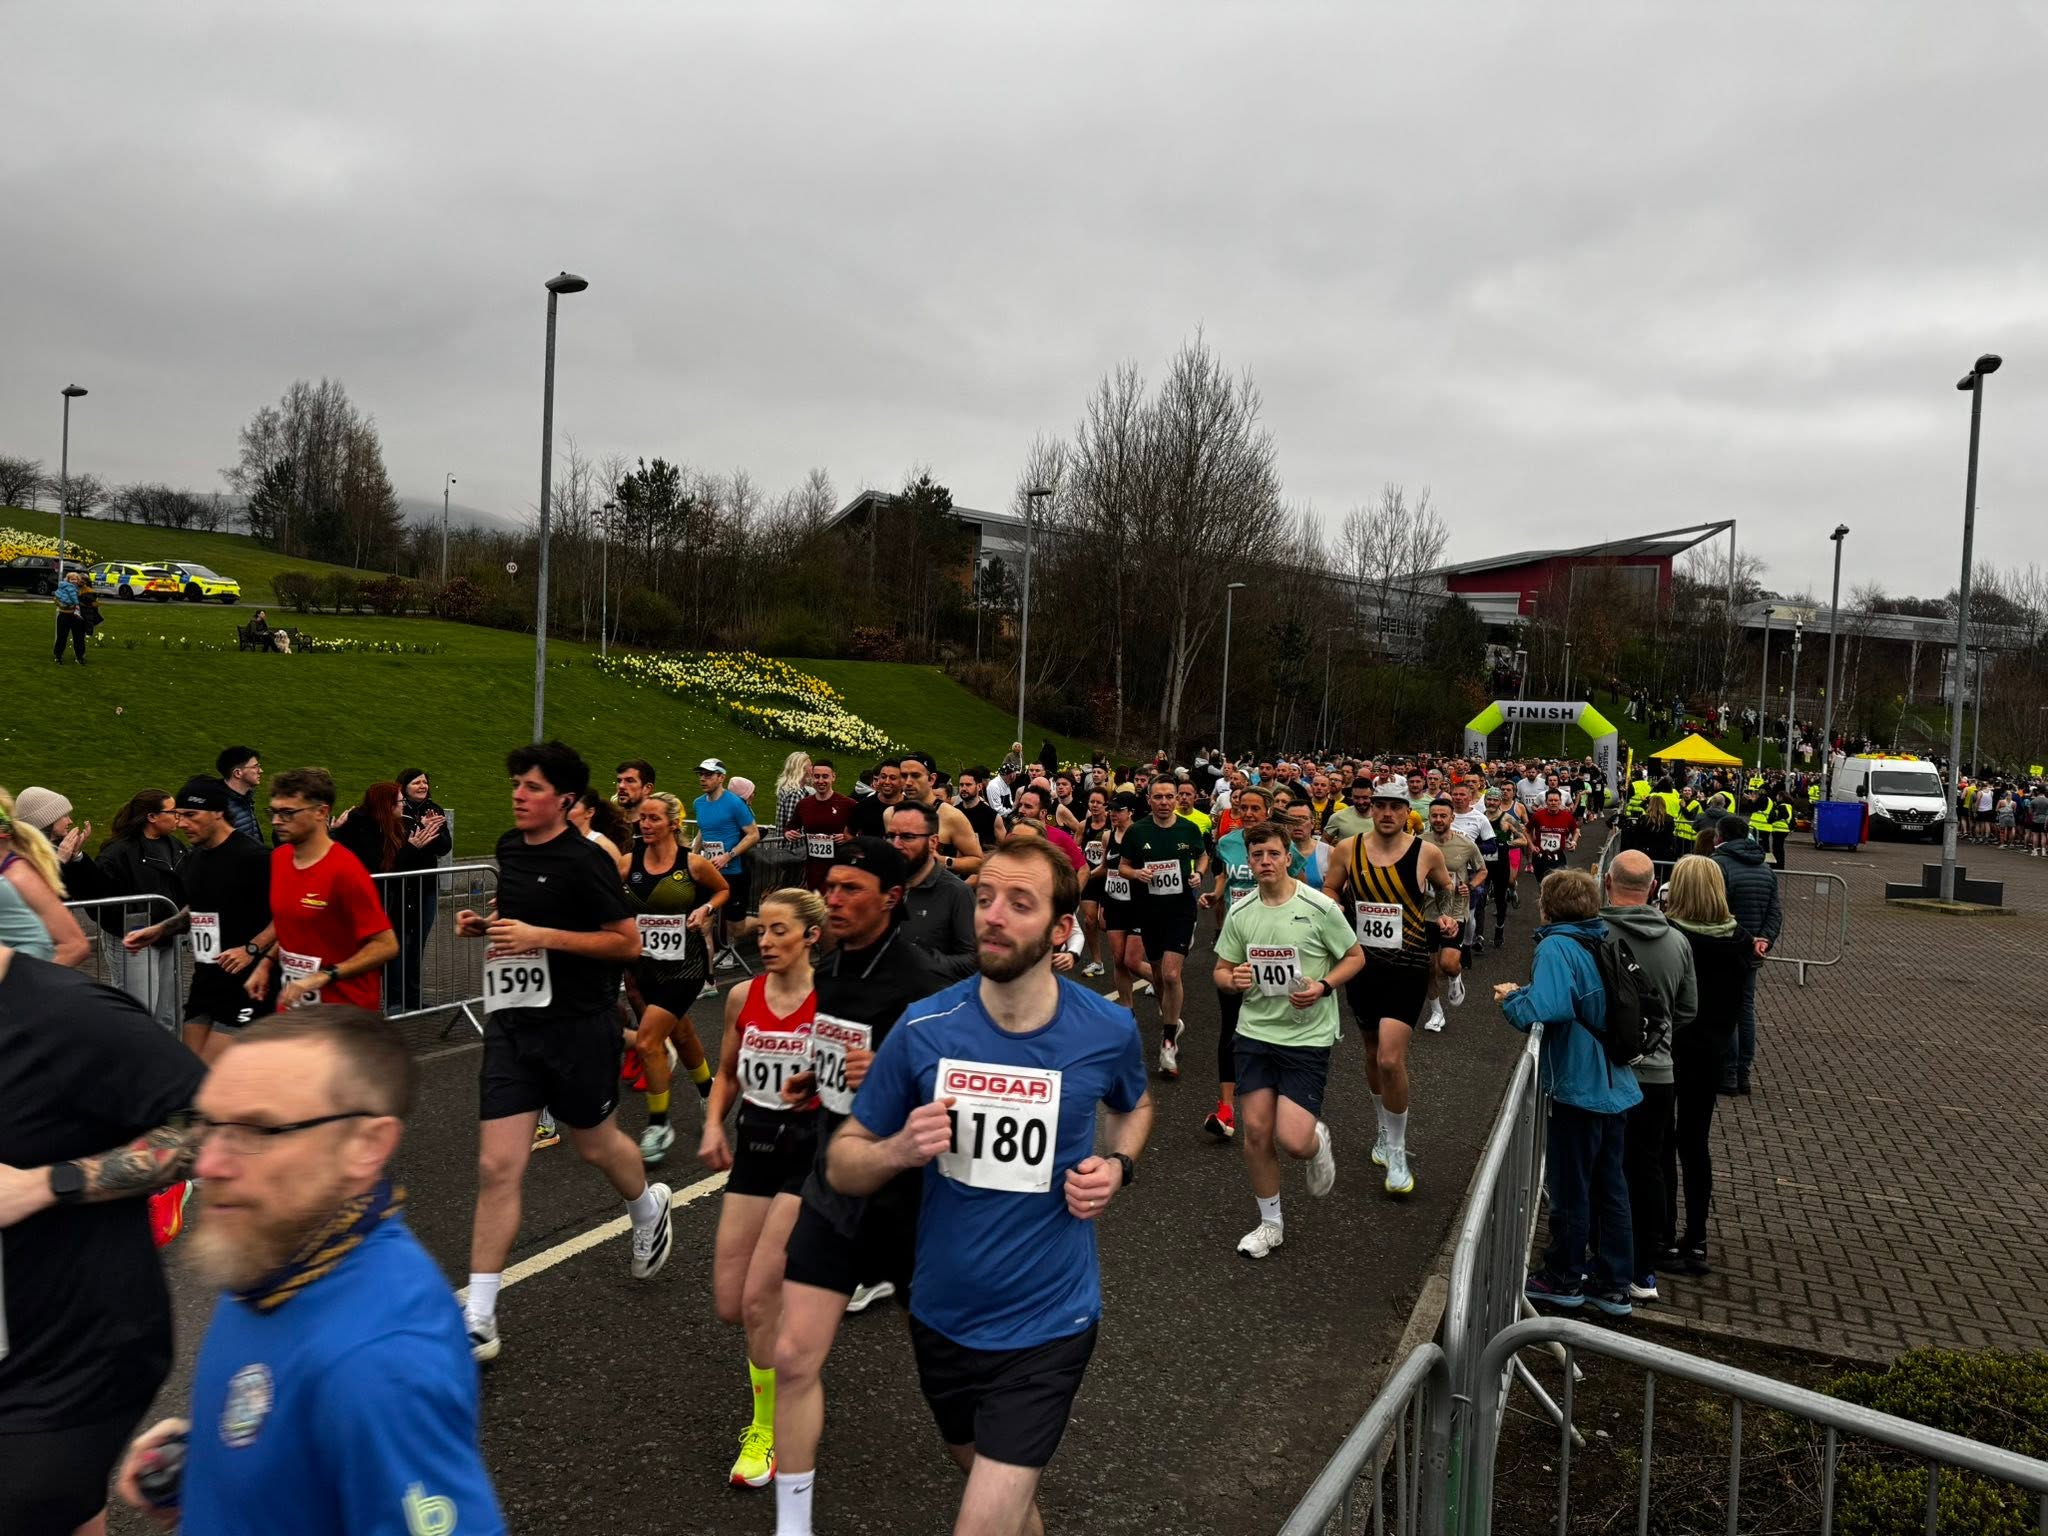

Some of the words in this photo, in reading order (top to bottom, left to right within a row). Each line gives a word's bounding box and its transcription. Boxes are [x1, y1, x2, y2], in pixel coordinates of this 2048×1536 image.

[1507, 706, 1574, 720] FINISH
[809, 843, 832, 855] 2328
[1543, 839, 1557, 849] 743
[1107, 881, 1128, 894] 1080
[1360, 905, 1398, 915] GOGAR
[1363, 920, 1394, 939] 486
[640, 931, 682, 951] 1399
[1251, 949, 1293, 958] GOGAR
[487, 967, 545, 997] 1599
[816, 1022, 864, 1044] GOGAR
[746, 1034, 804, 1051] GOGAR
[815, 1050, 847, 1093] 226
[949, 1072, 1047, 1098] GOGAR
[947, 1109, 1047, 1166] 1180
